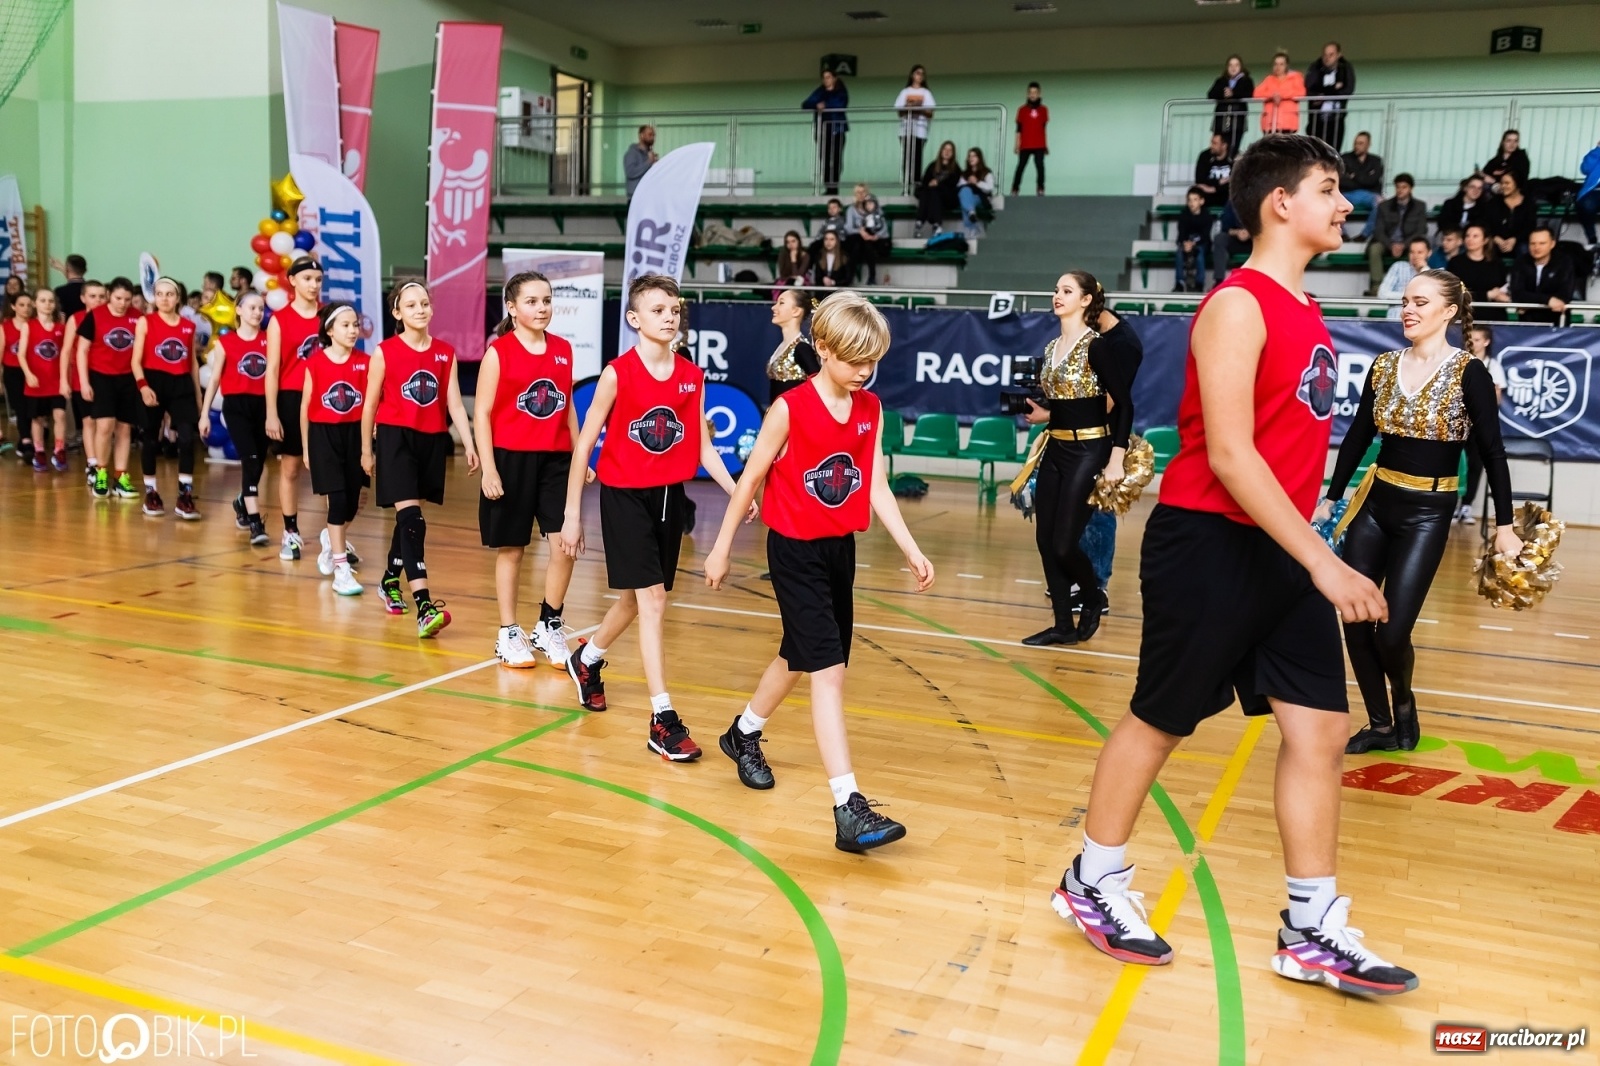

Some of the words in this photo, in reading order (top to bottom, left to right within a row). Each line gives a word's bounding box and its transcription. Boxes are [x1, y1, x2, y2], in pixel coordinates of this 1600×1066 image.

[1496, 36, 1511, 50] B
[1521, 35, 1536, 49] B
[836, 61, 852, 74] A
[9, 216, 27, 275] TBALL
[629, 218, 671, 276] iR
[667, 224, 685, 275] CIBÓRZ
[554, 305, 579, 315] OWY
[994, 299, 1010, 312] B
[677, 329, 729, 370] iR
[1335, 352, 1374, 399] R
[632, 420, 656, 431] HOUSTON
[666, 420, 682, 432] ROCKETS
[806, 469, 833, 481] HOUSTON
[844, 468, 859, 479] ROCKETS
